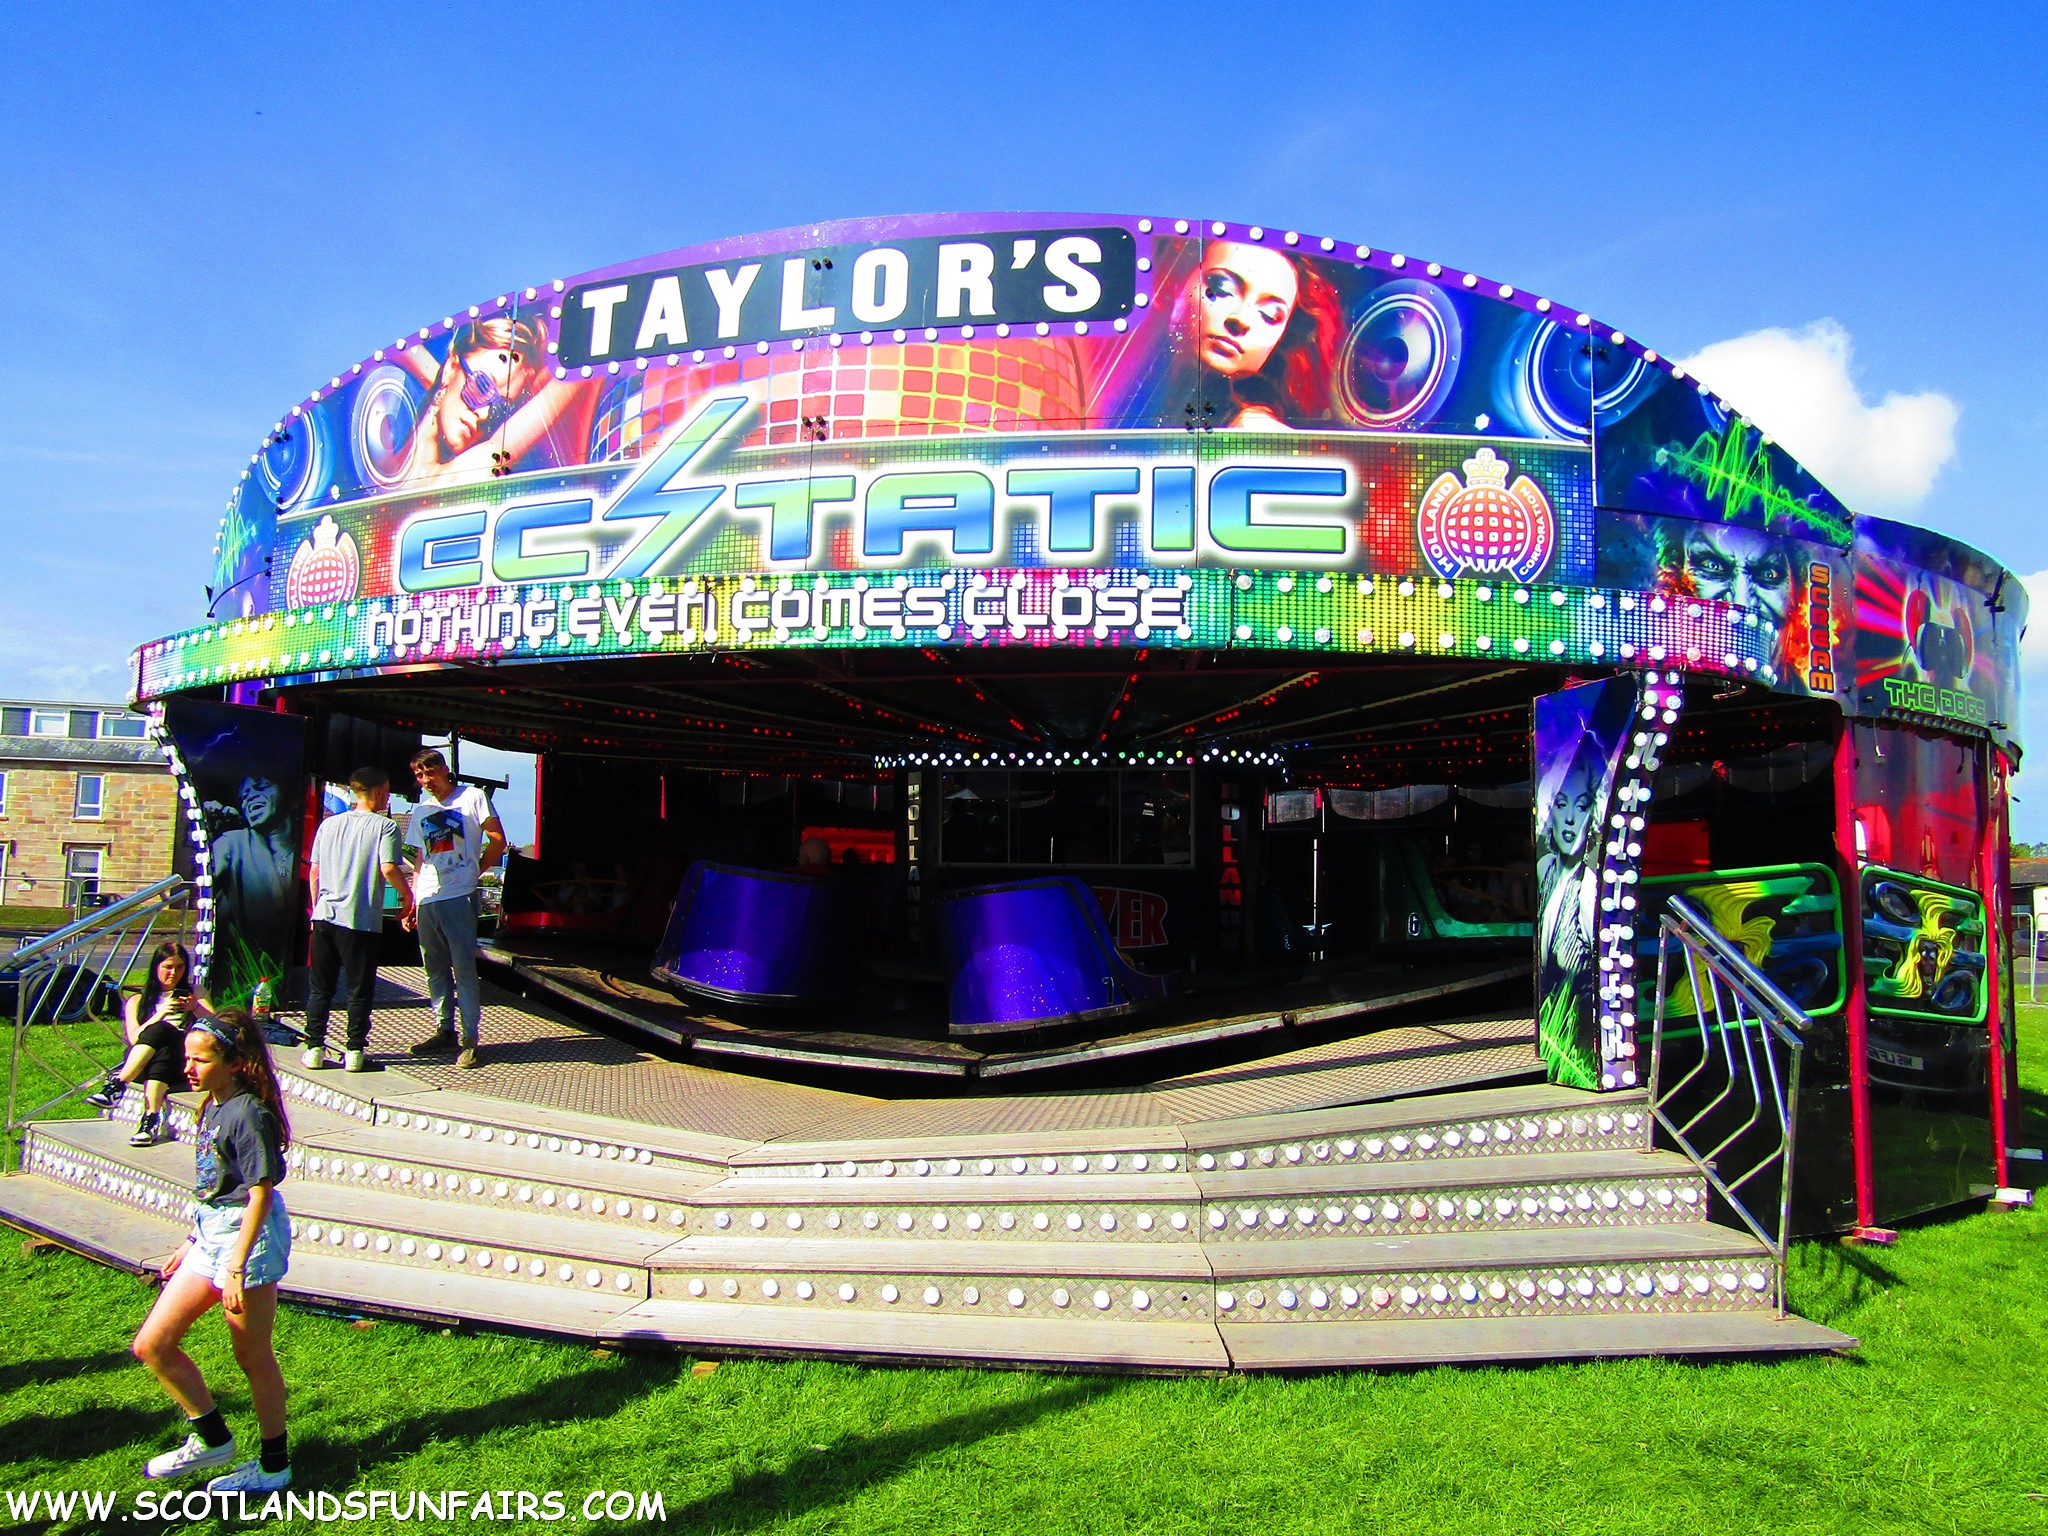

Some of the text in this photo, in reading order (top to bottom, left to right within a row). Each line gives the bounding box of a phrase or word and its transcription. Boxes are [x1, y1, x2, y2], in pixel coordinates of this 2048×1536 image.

[581, 235, 1103, 357] TAYLOR'S
[399, 397, 1346, 592] ECSTATIC
[1425, 482, 1546, 575] HOLLAND CORPORATION
[290, 548, 310, 609] OLLAND
[368, 585, 1186, 647] NOTHING EVEN COMES CLOSE
[1809, 562, 1836, 693] SCREAM
[1883, 677, 1986, 725] THE DOGS
